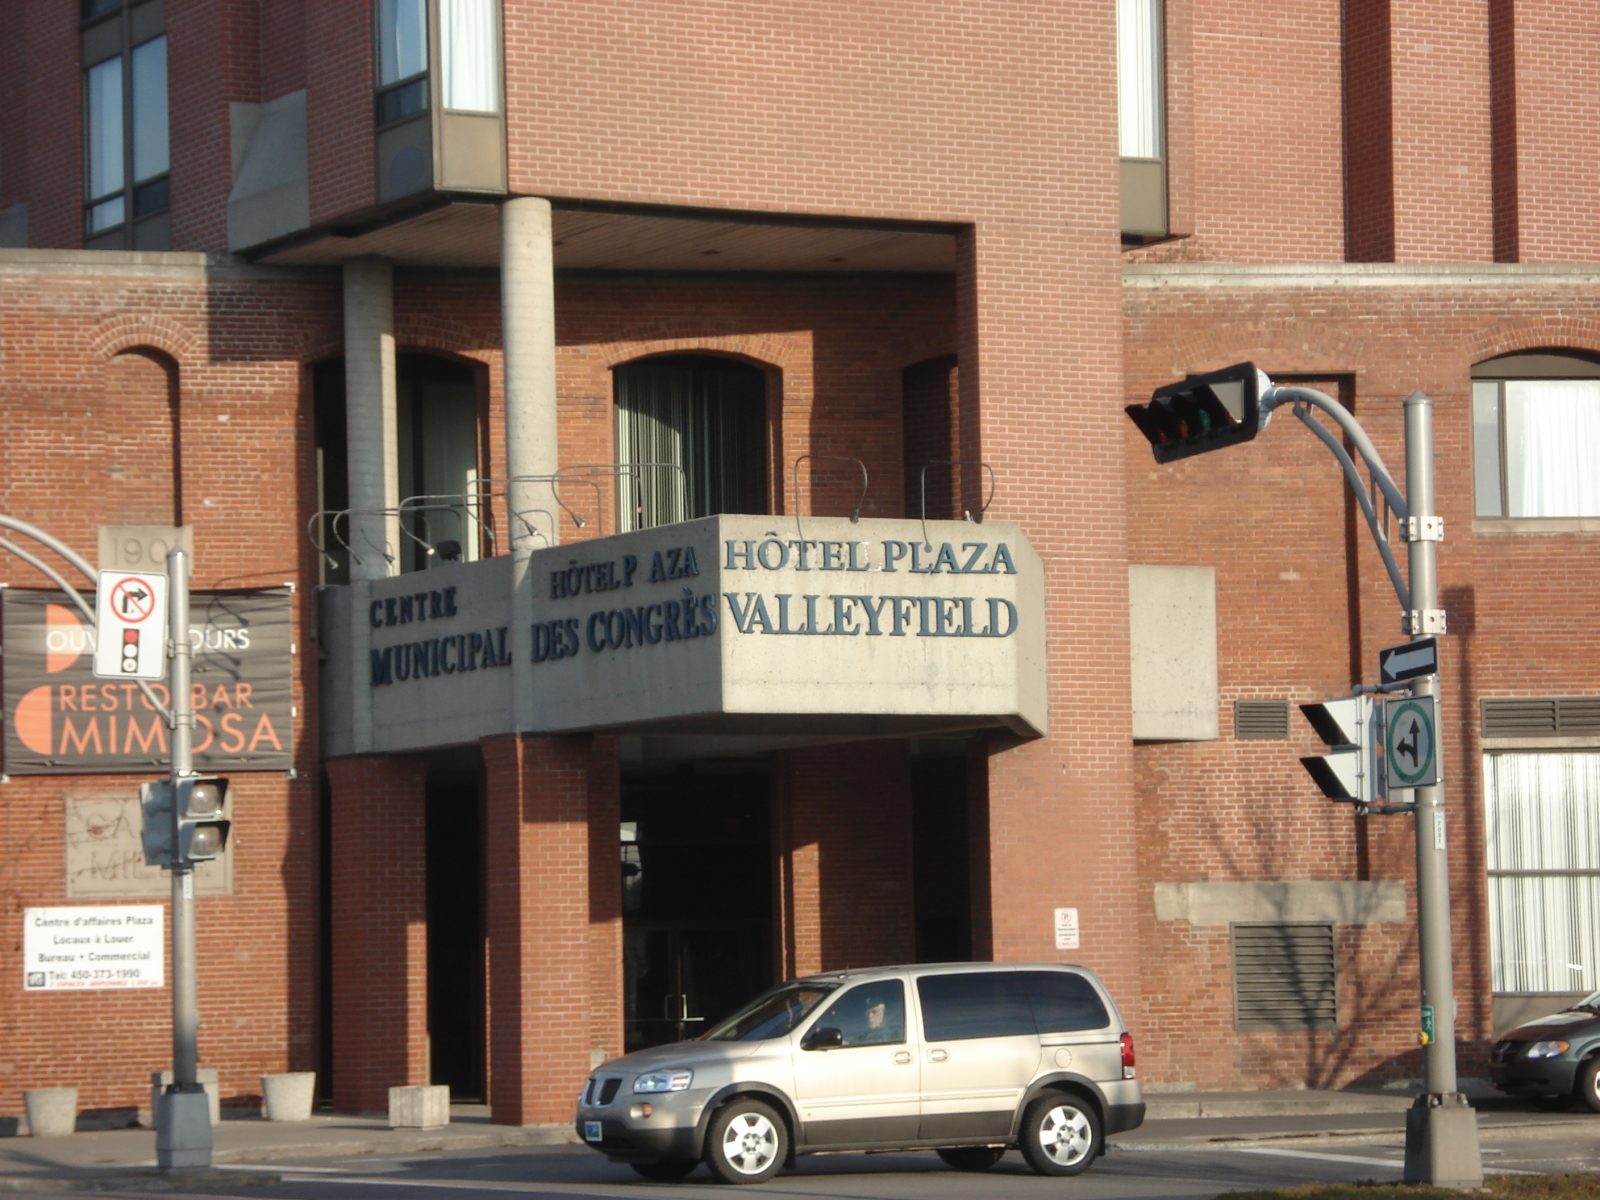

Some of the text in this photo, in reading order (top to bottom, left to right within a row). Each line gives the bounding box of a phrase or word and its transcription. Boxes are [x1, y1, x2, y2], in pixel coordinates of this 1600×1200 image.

[724, 531, 1018, 575] HÔTEL PLAZA
[550, 559, 621, 600] HÔTEL
[370, 586, 457, 628] CENTRE
[531, 586, 718, 664] DES CONGRÈS
[723, 592, 1019, 638] VALLEYFIELD
[187, 628, 251, 650] OURS
[370, 626, 512, 687] MUNICIPAL
[59, 682, 254, 712] RESTO BAR
[34, 917, 70, 927] Centre
[125, 915, 154, 925] Plaza
[52, 936, 91, 945] Locaux
[104, 934, 134, 943] Louer
[37, 951, 151, 962] Bureau Commercial
